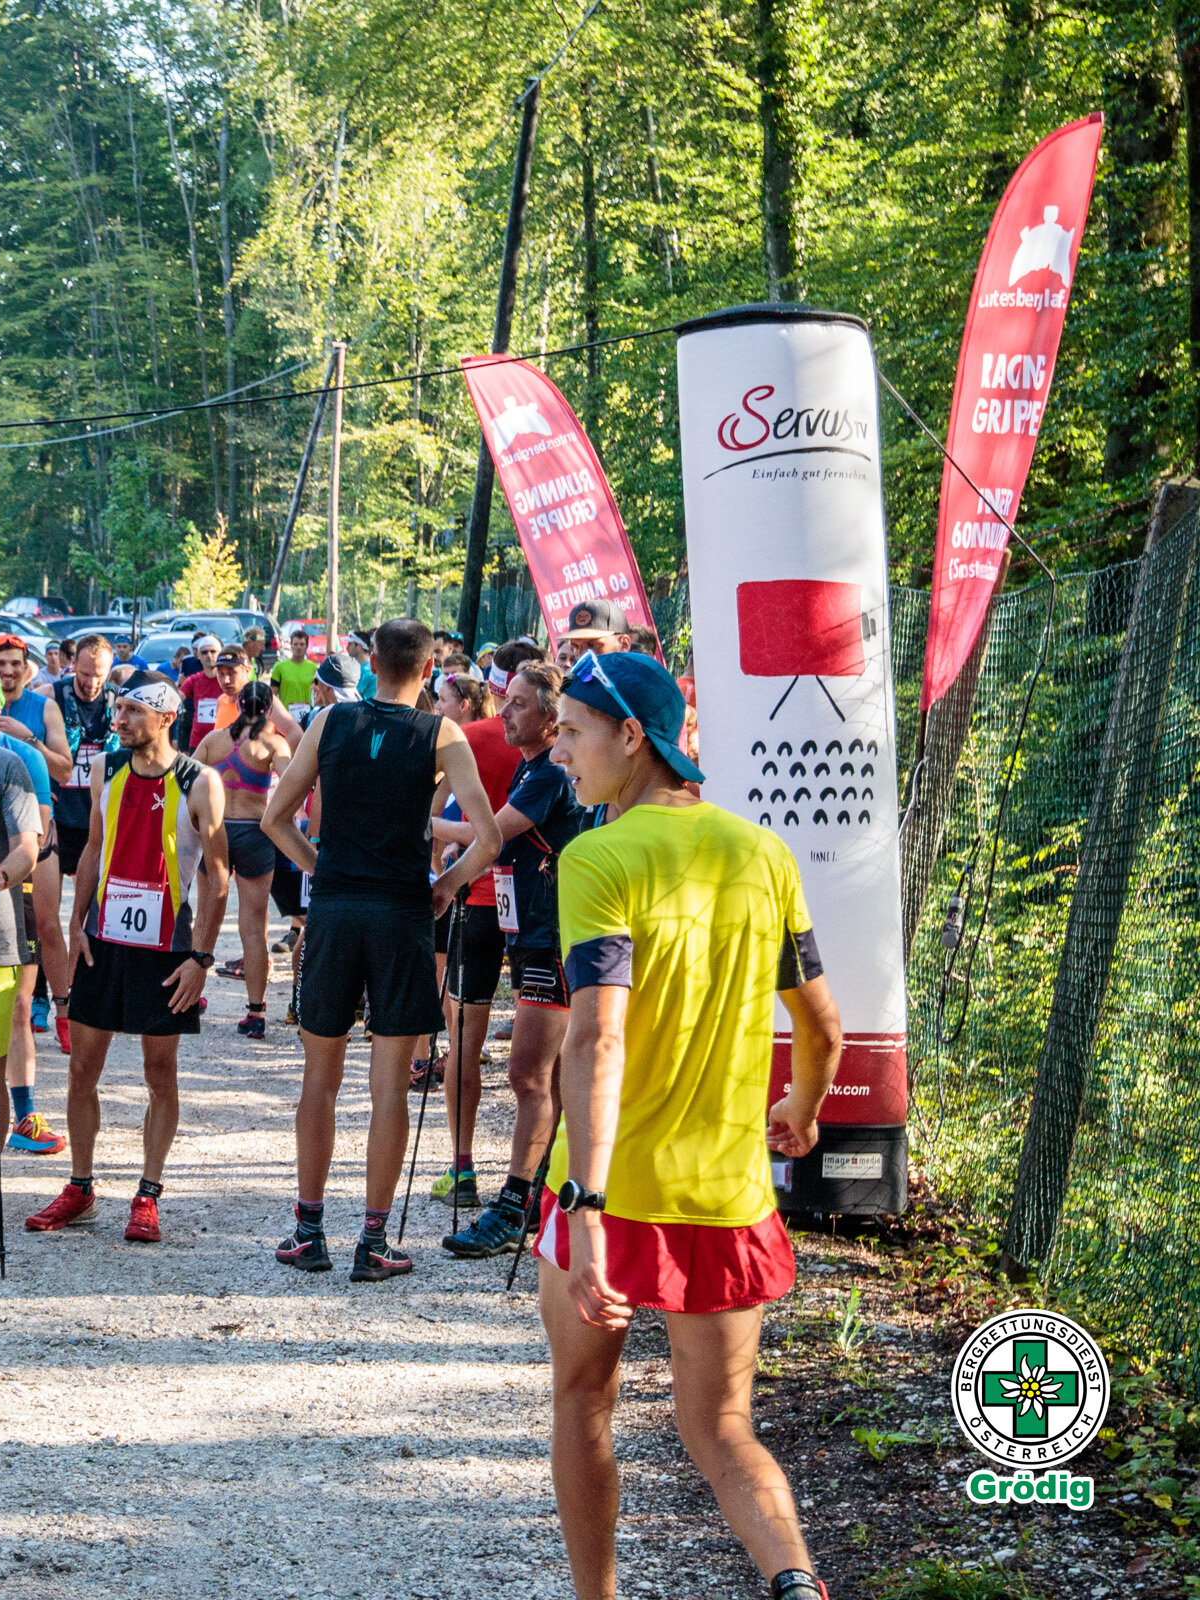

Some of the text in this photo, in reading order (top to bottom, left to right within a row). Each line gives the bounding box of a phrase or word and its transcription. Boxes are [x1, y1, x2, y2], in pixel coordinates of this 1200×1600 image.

[752, 468, 798, 482] Einfach
[802, 468, 820, 481] gut
[120, 906, 147, 933] 40
[824, 1155, 850, 1165] image
